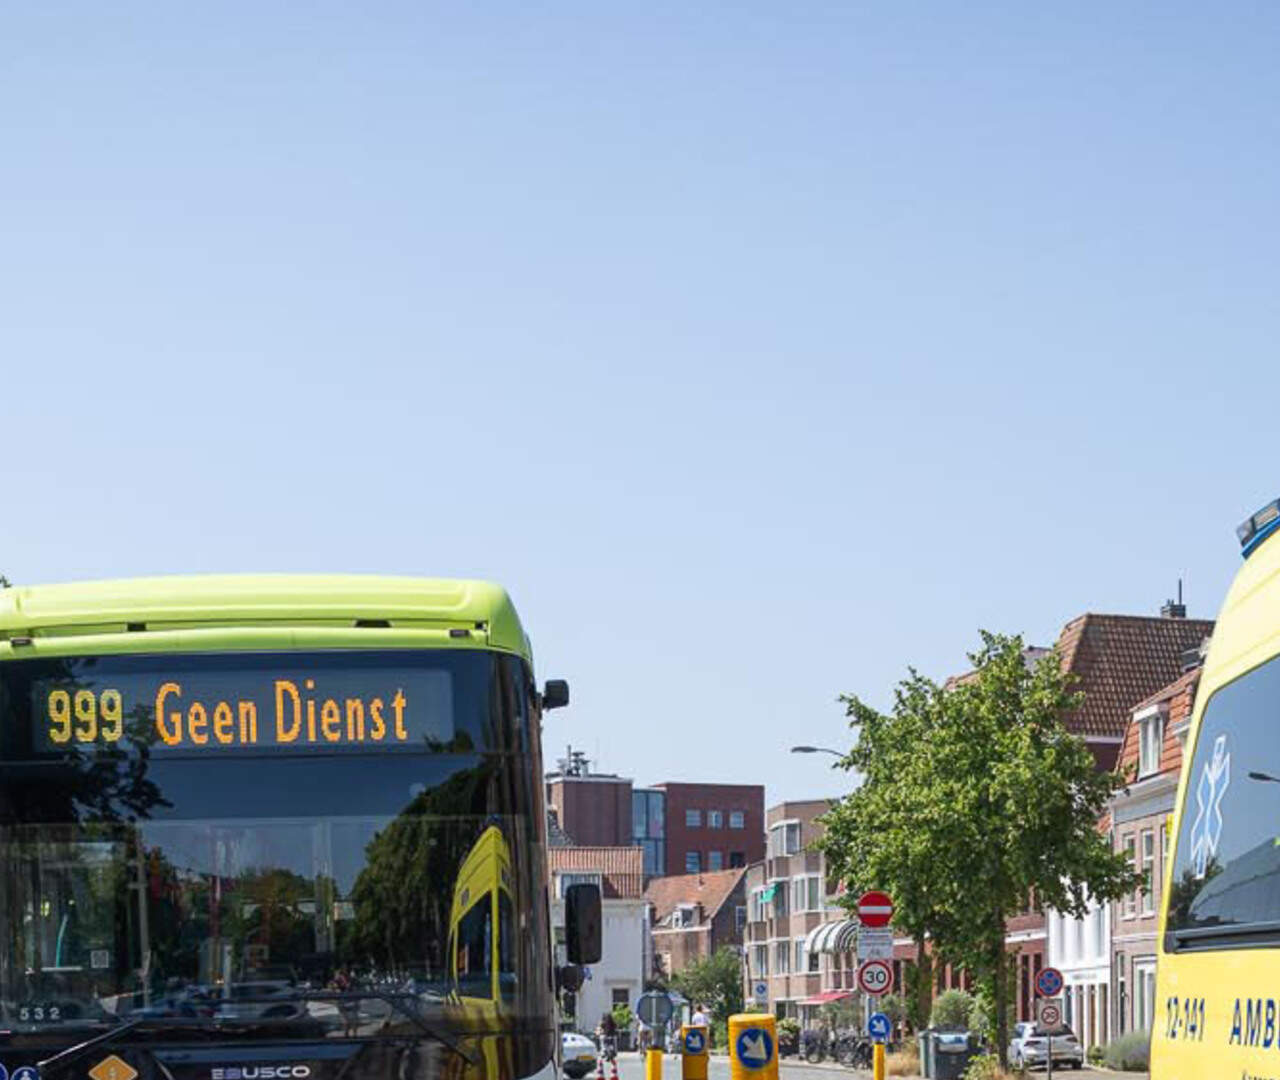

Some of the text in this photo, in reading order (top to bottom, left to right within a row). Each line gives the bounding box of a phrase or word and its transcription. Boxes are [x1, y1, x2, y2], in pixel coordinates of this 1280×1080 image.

[48, 680, 408, 745] 999 Geen Dienst
[865, 970, 887, 984] 30
[1166, 997, 1206, 1041] 12-141
[211, 1065, 311, 1080] EBUSCO
